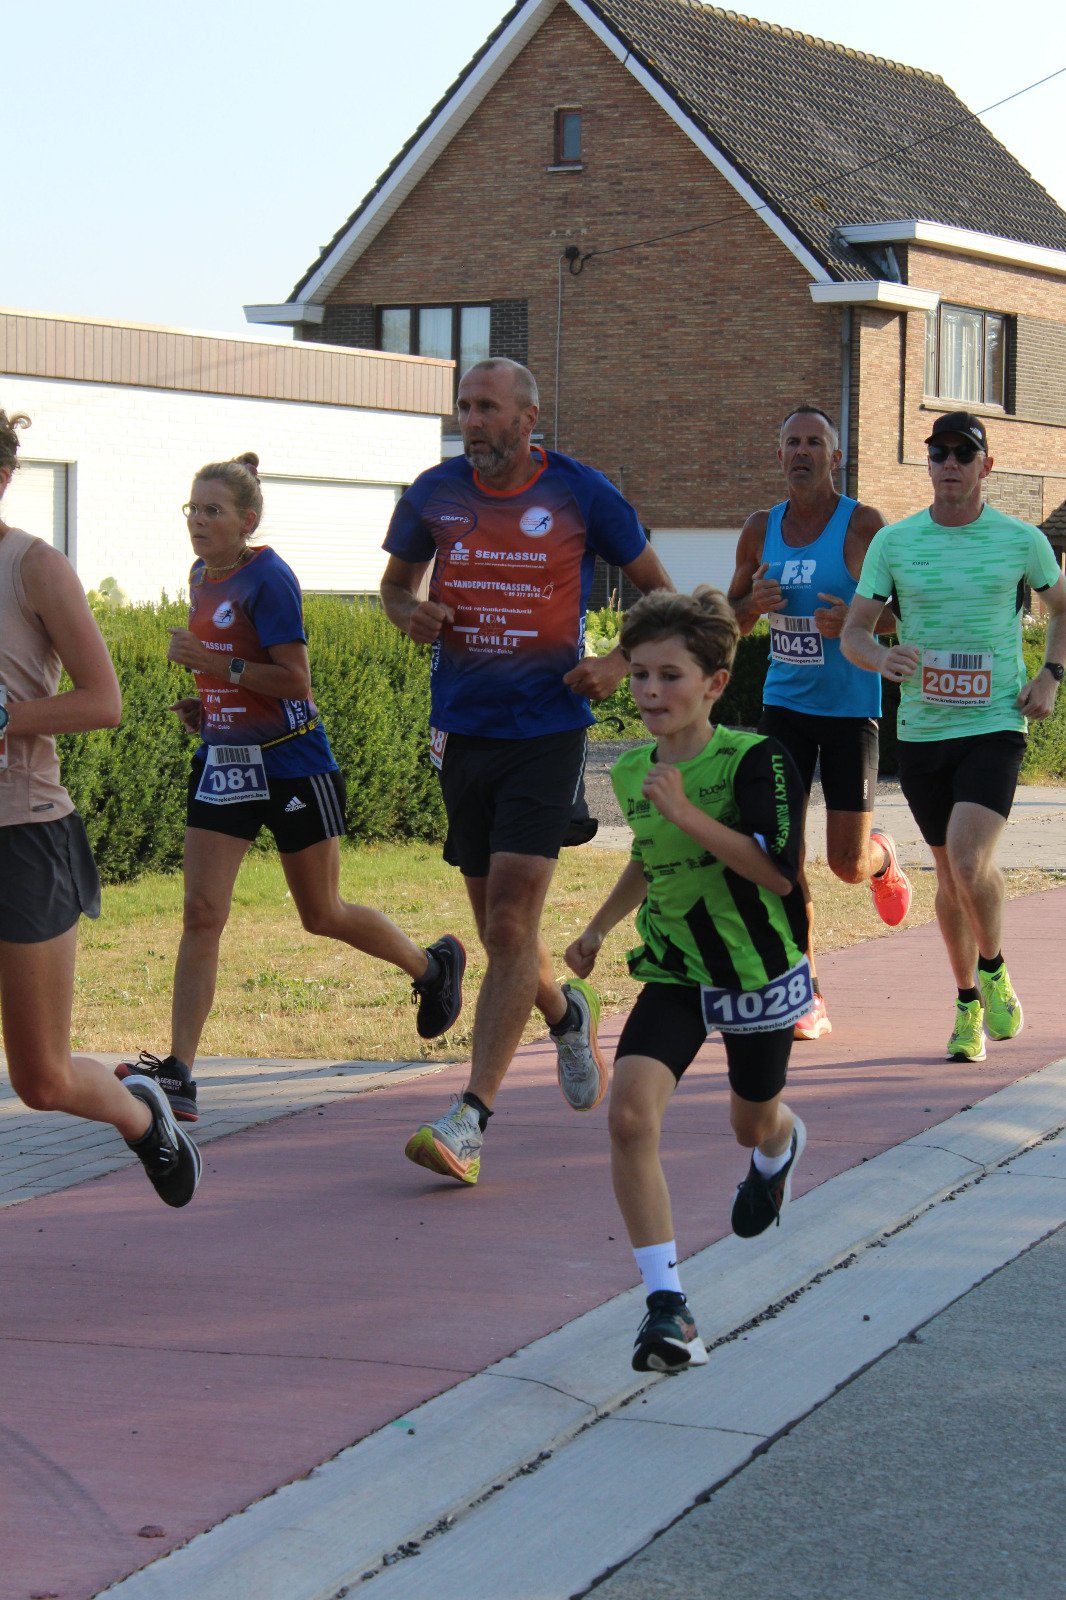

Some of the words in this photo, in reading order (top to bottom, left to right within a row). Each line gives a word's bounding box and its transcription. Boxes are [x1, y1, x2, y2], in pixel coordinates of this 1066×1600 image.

[450, 553, 470, 561] KBC
[475, 549, 547, 562] SENTASSUR
[479, 613, 507, 625] TOM
[201, 640, 234, 652] TASSUR
[465, 634, 521, 648] DEWILDE
[773, 632, 819, 655] 1043
[925, 671, 988, 695] 2050
[771, 754, 787, 801] LUCKY
[284, 802, 307, 813] adidas
[712, 973, 808, 1022] 1028
